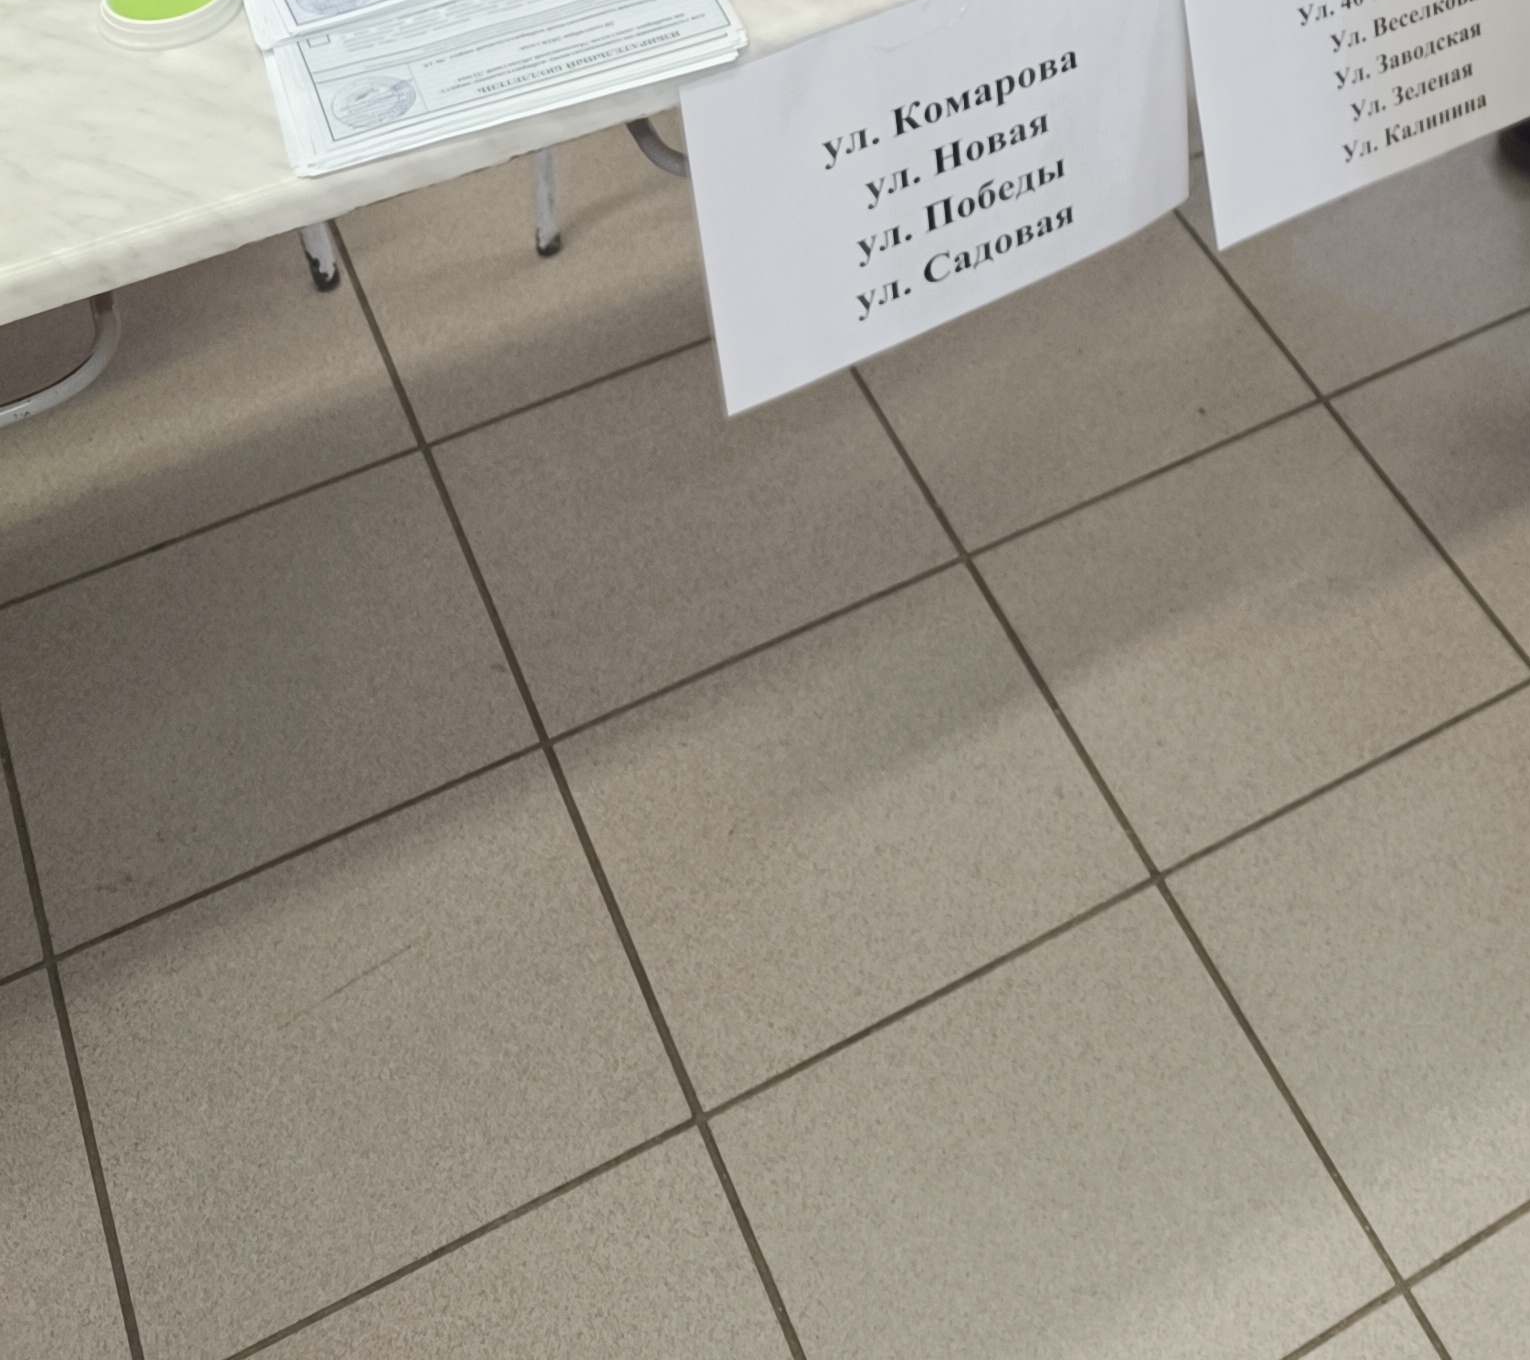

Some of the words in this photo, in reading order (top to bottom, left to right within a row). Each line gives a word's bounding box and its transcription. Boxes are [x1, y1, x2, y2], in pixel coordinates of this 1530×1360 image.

[1298, 3, 1335, 26] Ул.
[1330, 30, 1367, 53] Ул.
[1335, 67, 1370, 90] Ул.
[1377, 21, 1482, 74] Заводская
[822, 127, 880, 169] ул.
[891, 50, 1078, 138] Комарова
[1350, 100, 1387, 122] Ул.
[1392, 62, 1473, 107] Зеленая
[866, 169, 921, 210] ул.
[932, 113, 1050, 176] Новая
[1342, 141, 1378, 164] Ул.
[1385, 93, 1487, 146] Калинина
[857, 226, 913, 267] ул.
[924, 158, 1066, 232] Победы
[856, 280, 912, 321] ул.
[923, 205, 1075, 283] Садовая
